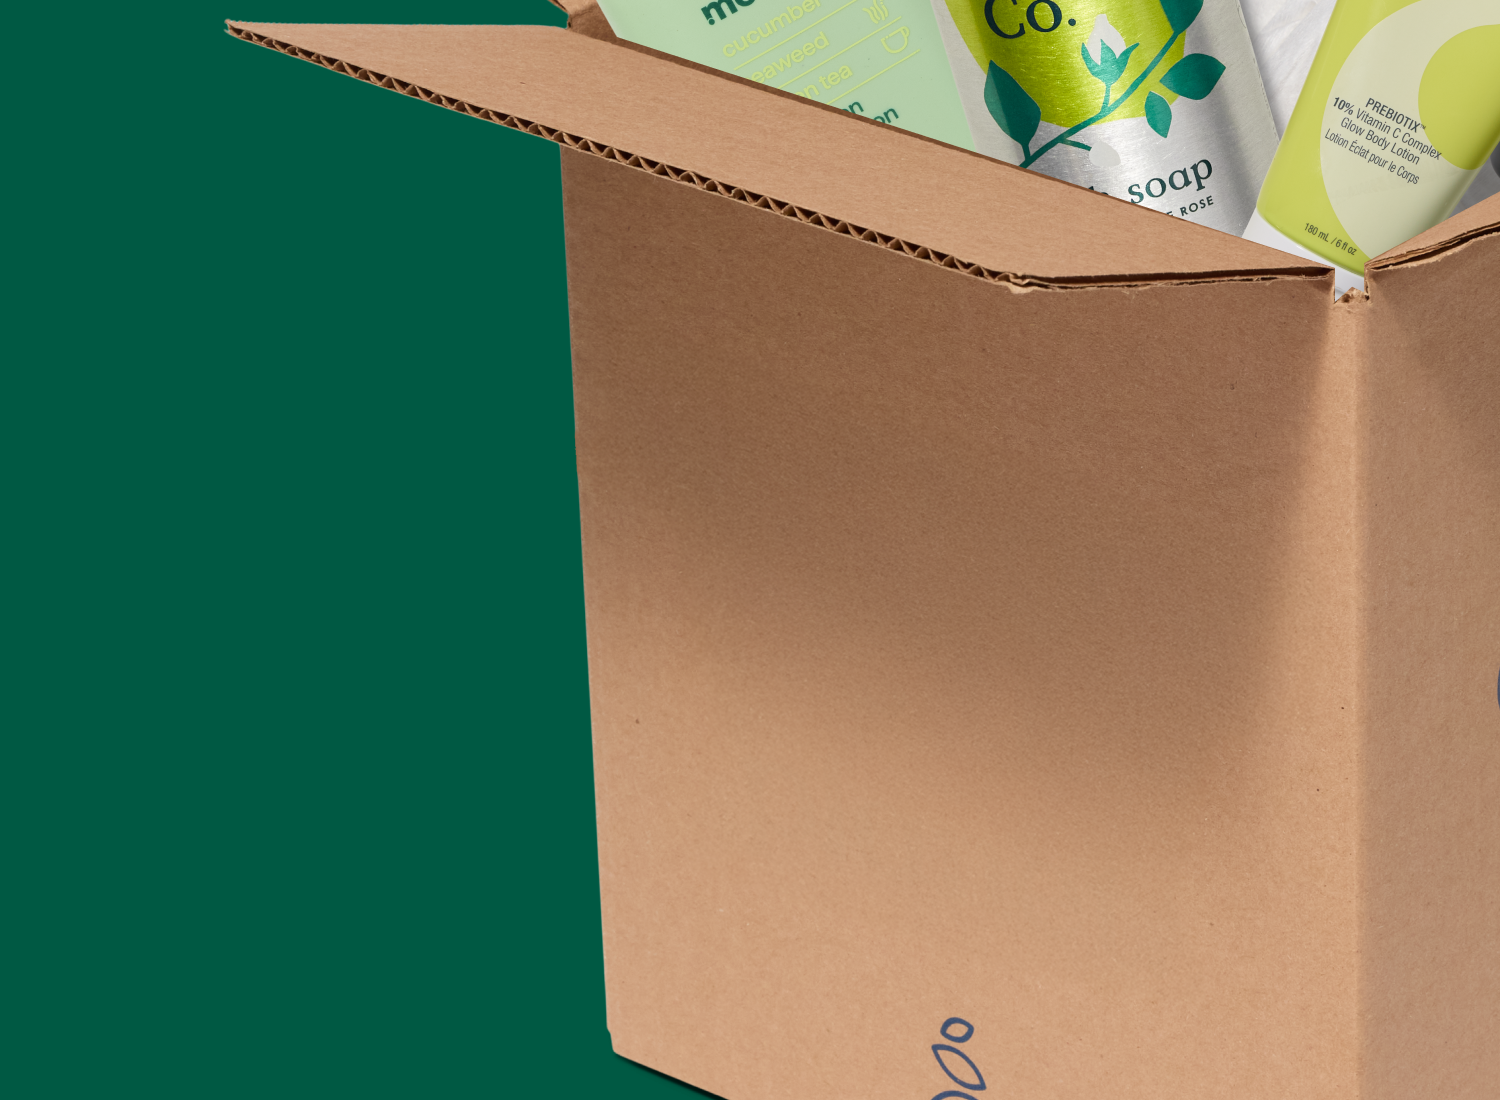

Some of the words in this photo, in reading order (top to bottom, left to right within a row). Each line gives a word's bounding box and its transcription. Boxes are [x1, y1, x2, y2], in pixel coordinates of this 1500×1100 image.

[751, 31, 830, 84] eaweed
[818, 64, 853, 90] tea
[1333, 97, 1355, 115] 10%
[1356, 107, 1391, 134] Vitamin
[1392, 127, 1402, 138] C
[1401, 132, 1442, 160] Complex
[1340, 116, 1365, 136] Glow
[1365, 129, 1390, 151] Body
[1390, 142, 1420, 165] Lotion
[1324, 128, 1349, 148] Lotion
[1348, 139, 1370, 159] Éclat
[1367, 152, 1388, 168] pour
[1387, 161, 1397, 173] le
[1396, 165, 1420, 184] Corps
[1128, 159, 1213, 204] soap
[1180, 195, 1214, 216] ROSE
[1305, 223, 1318, 235] 180
[1317, 231, 1329, 242] mL
[1341, 241, 1348, 250] fl
[1347, 246, 1357, 255] oz
